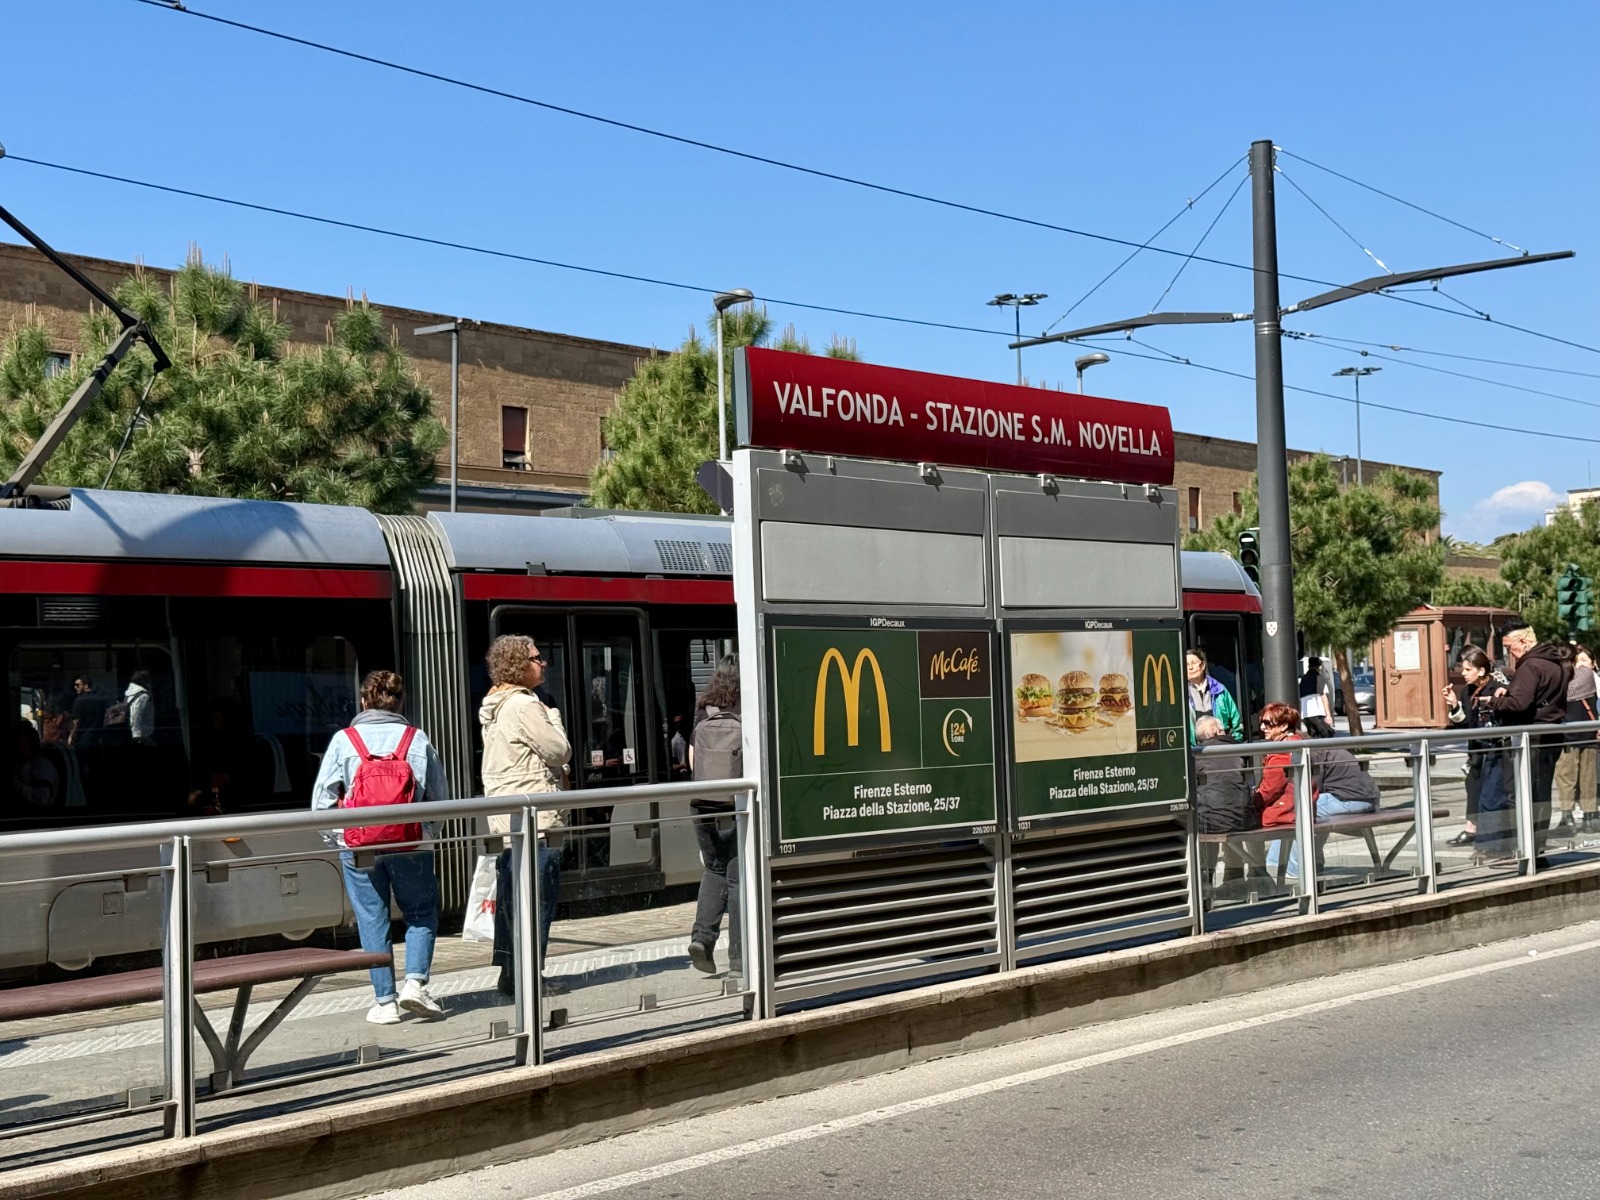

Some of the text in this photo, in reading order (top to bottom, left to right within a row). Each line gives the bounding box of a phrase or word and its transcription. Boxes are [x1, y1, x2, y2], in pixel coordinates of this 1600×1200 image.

[773, 381, 1162, 456] VALFONDA - STAZIONE S.M. NOVELLA
[870, 617, 906, 628] IGPDecaux
[930, 647, 979, 681] McCafé
[953, 722, 966, 736] 24
[1073, 765, 1136, 782] Firenze Esterno
[853, 782, 933, 799] Firenze Esterno
[1049, 778, 1159, 800] Piazza della Stazione, 25/37
[823, 796, 961, 820] Piazza della Stazione, 25/37
[1017, 821, 1031, 830] 1031
[779, 844, 796, 854] 1031
